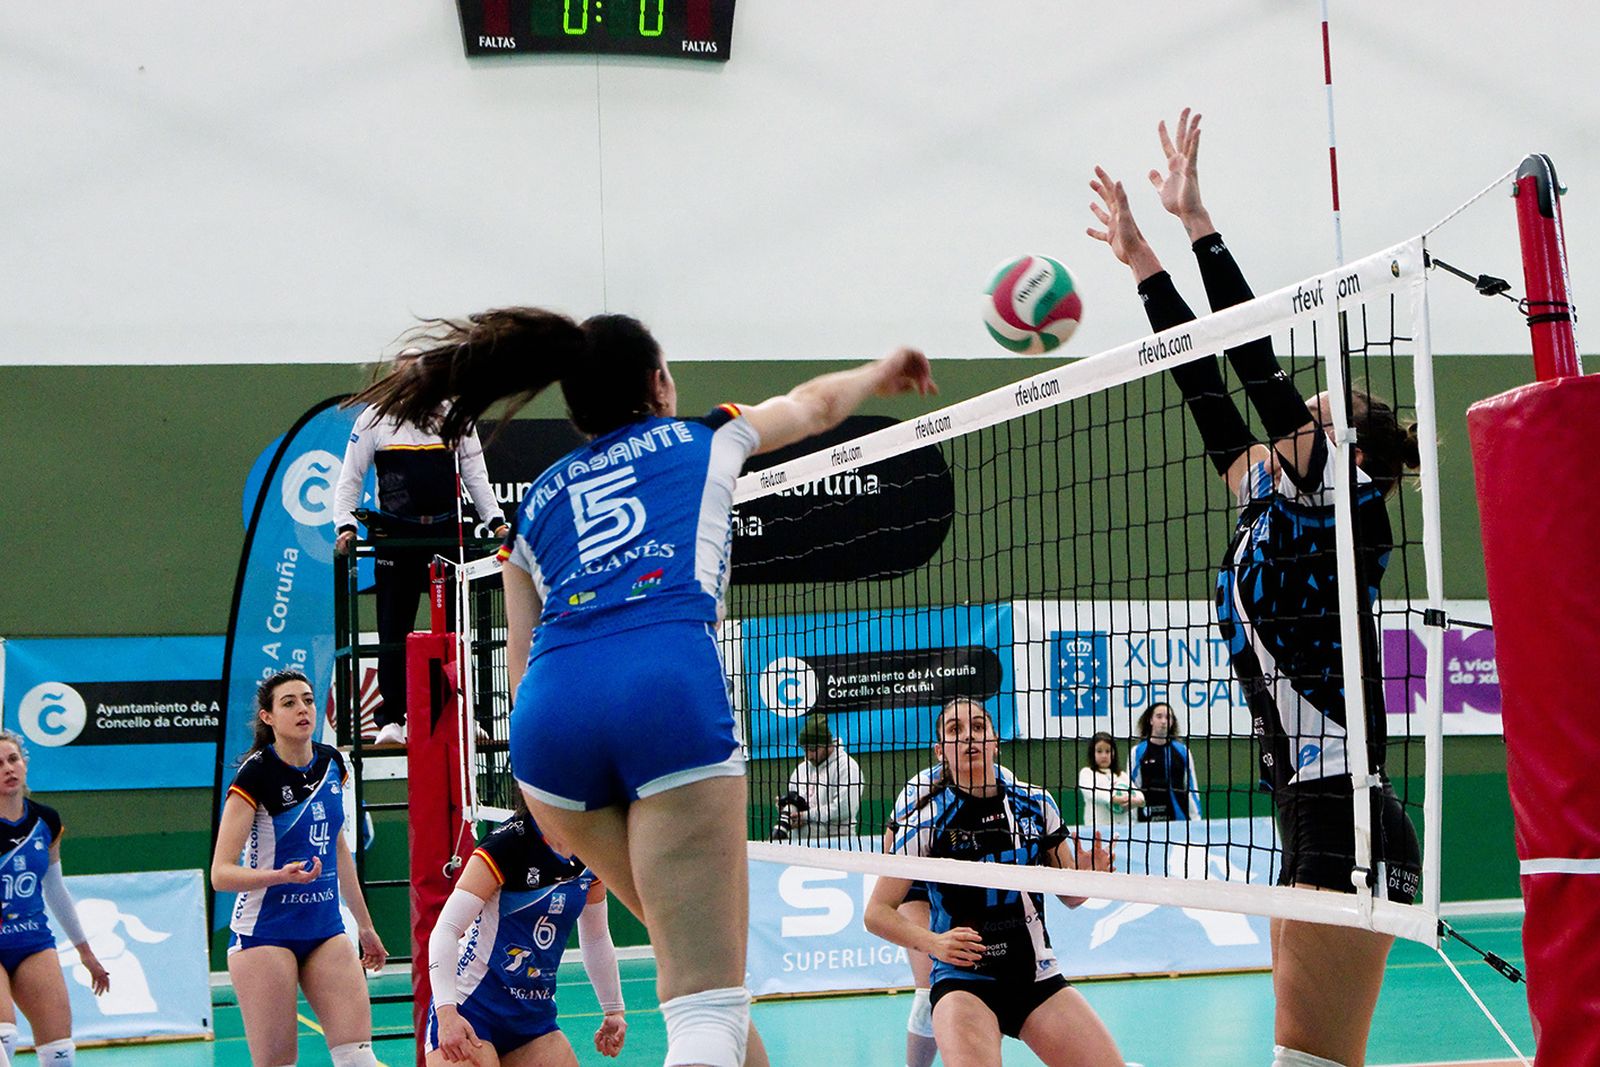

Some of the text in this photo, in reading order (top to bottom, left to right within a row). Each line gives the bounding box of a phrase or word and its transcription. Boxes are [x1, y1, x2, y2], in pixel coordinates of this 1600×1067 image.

[479, 36, 516, 49] FALTAS
[682, 41, 718, 53] FALTAS
[1138, 333, 1193, 366] rfevb.com
[1014, 377, 1060, 407] rfevb.com
[914, 415, 952, 440] rfevb.com
[831, 445, 863, 467] rfevb.com
[567, 465, 647, 564] 5
[266, 547, 299, 633] Coruña
[261, 641, 281, 661] A
[827, 671, 905, 687] Ayuntamiento
[907, 667, 922, 680] de
[936, 664, 977, 678] Coruña
[1450, 671, 1475, 684] de
[828, 681, 935, 699] Concello da Coruña
[1123, 679, 1168, 709] DE
[96, 701, 220, 717] Ayuntamiento de A
[96, 714, 219, 729] Concello da Coruña
[309, 822, 331, 855] 4
[2, 871, 38, 900] 10
[533, 915, 557, 950] 6
[783, 945, 908, 972] SUPERLIGA
